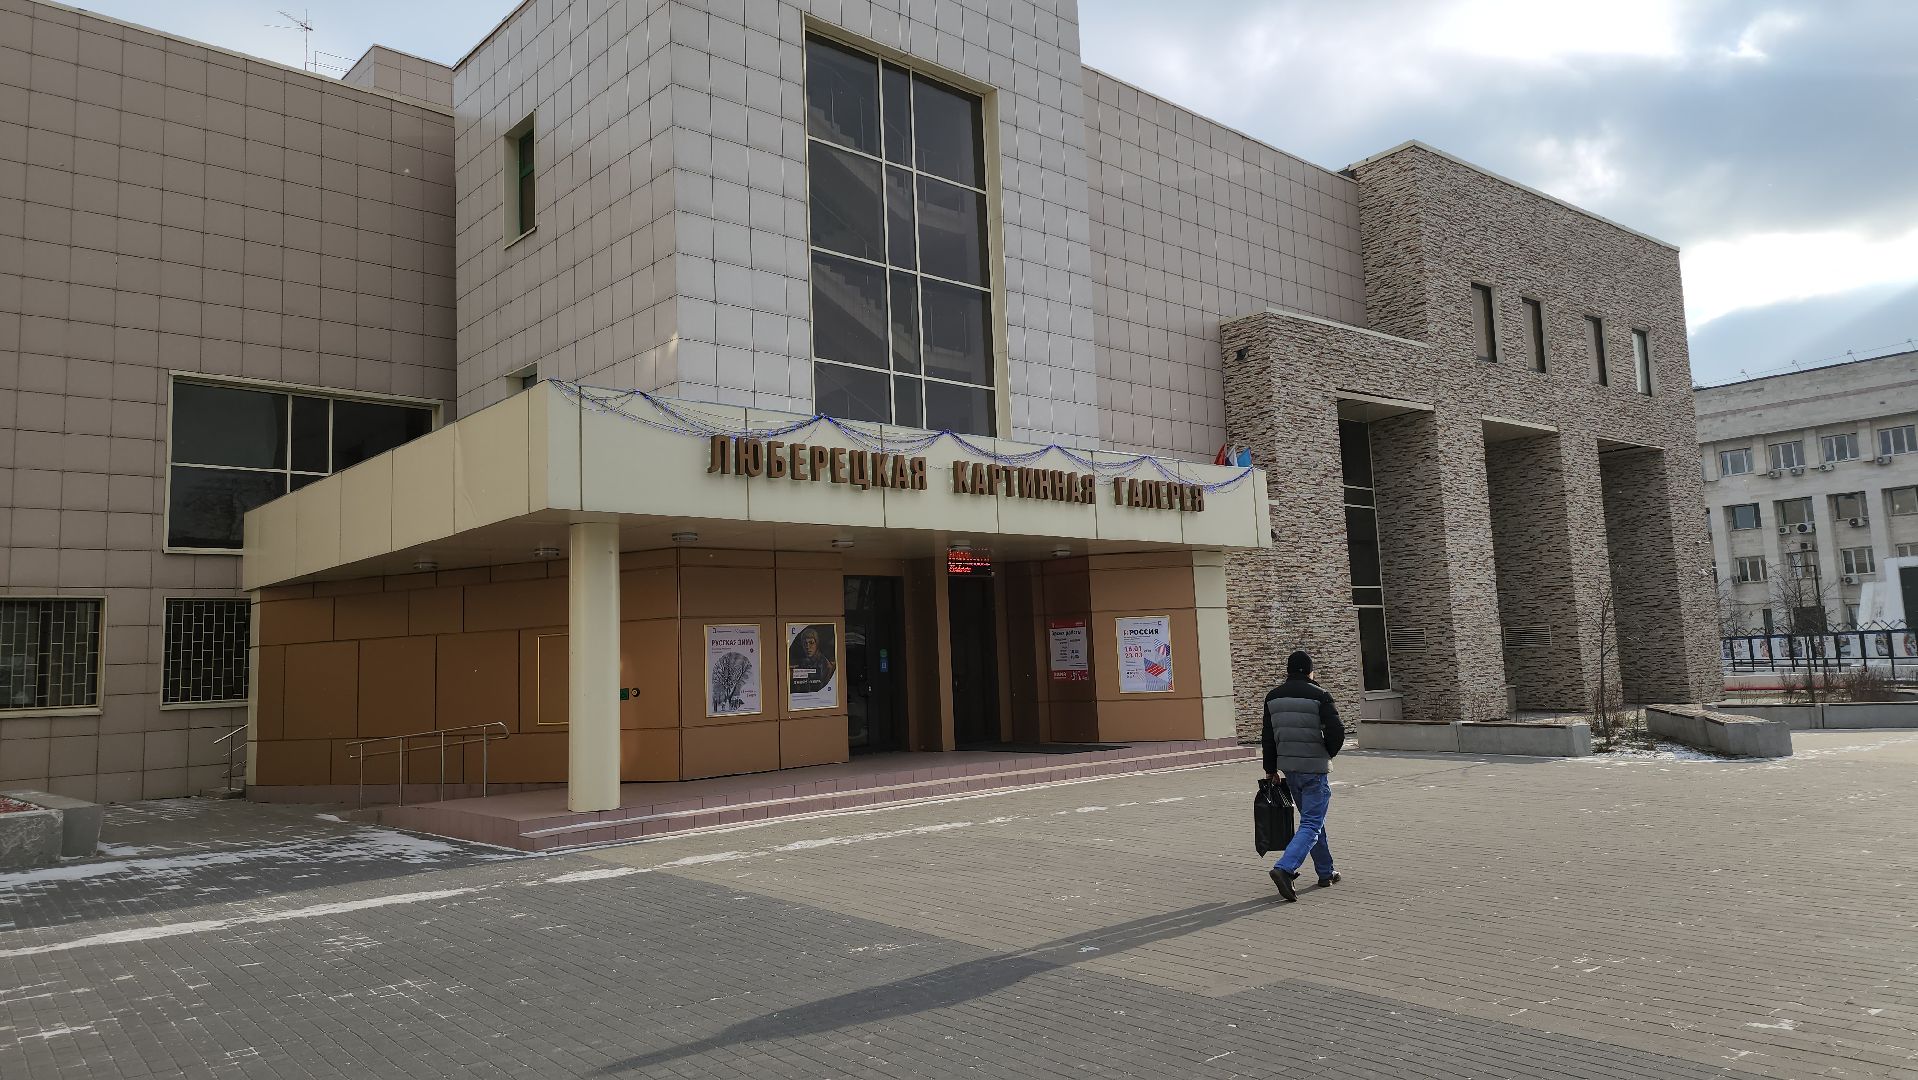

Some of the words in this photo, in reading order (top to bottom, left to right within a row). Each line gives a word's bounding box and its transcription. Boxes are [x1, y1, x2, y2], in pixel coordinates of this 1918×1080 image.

[707, 435, 928, 491] ЛЮБЕРЕЦКАЯ
[952, 459, 1097, 505] КАРТИННАЯ
[1113, 476, 1205, 512] ГАЛЕРЕЯ
